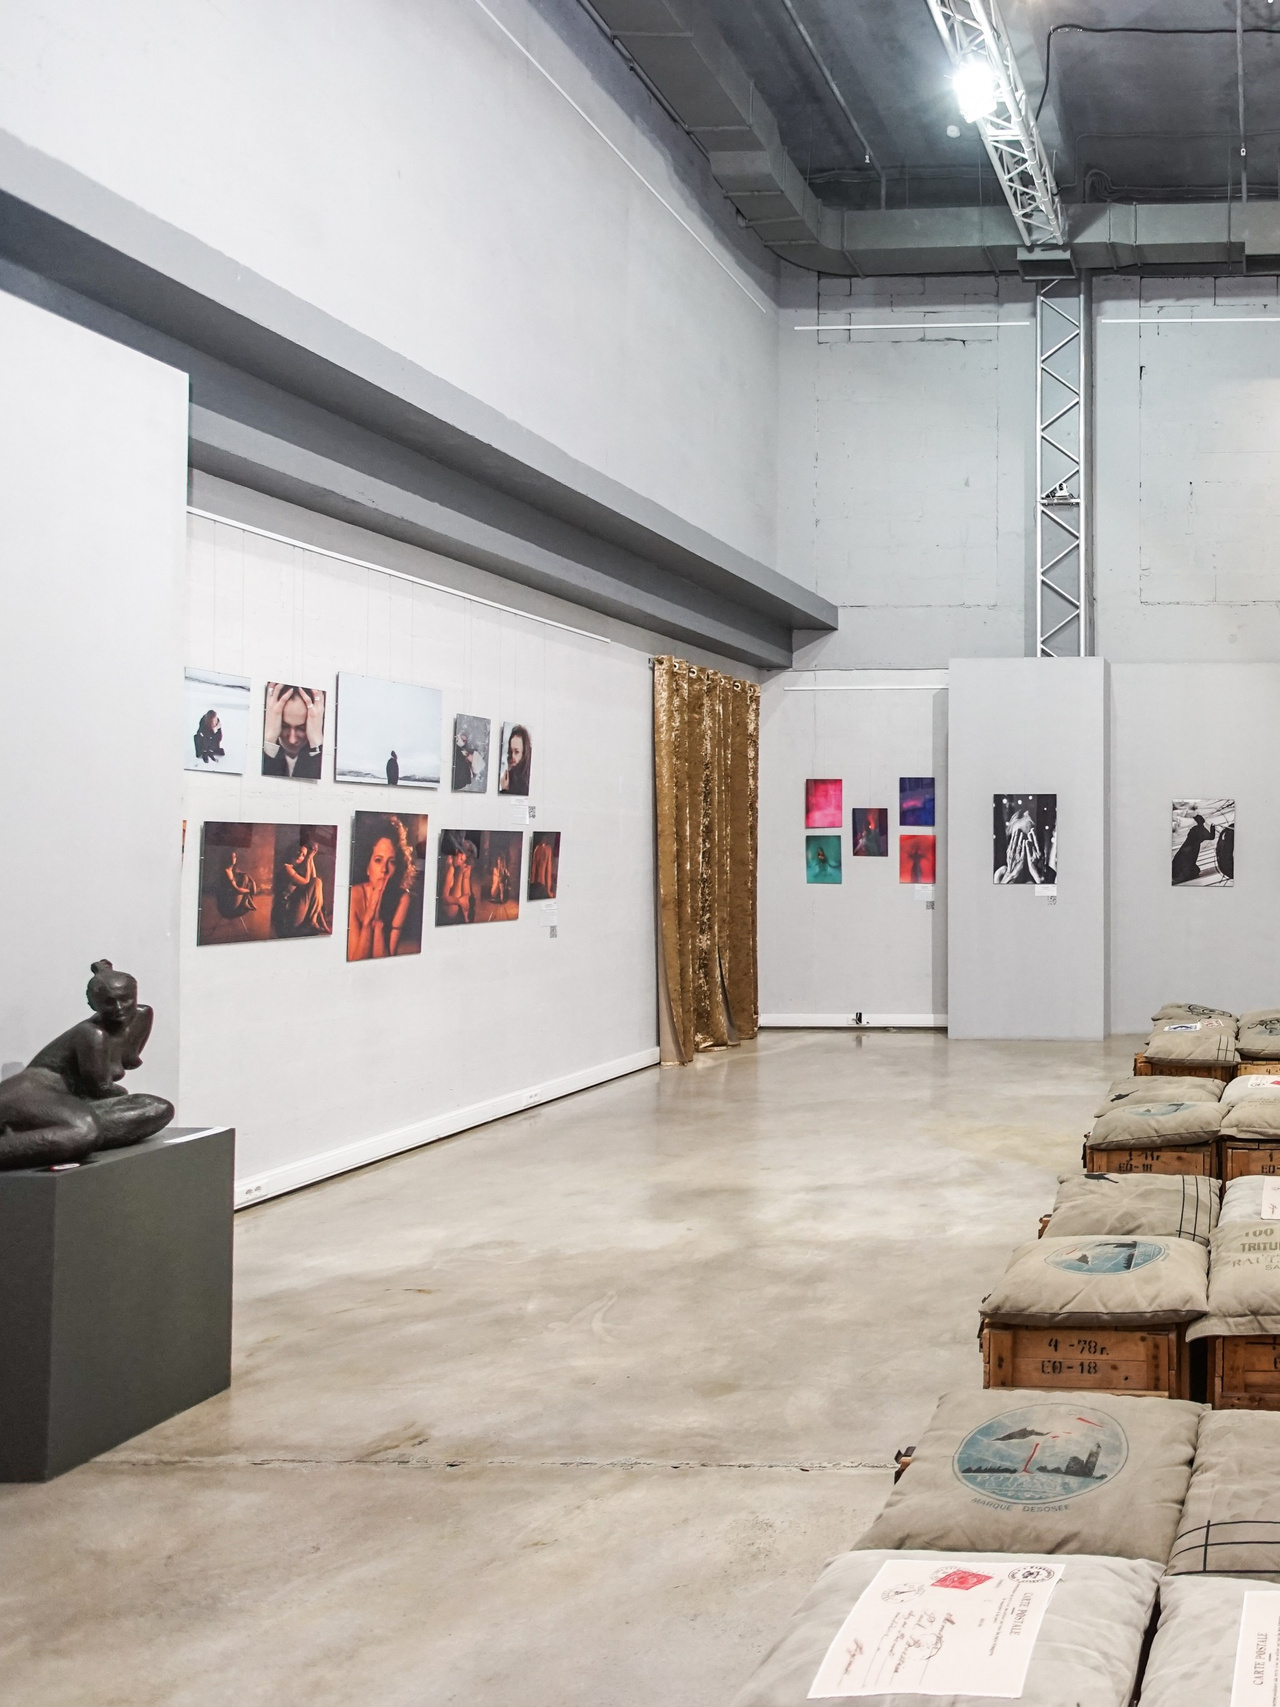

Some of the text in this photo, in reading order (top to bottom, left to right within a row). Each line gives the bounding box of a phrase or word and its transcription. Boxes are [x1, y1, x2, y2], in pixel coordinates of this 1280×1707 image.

[971, 1497, 1013, 1512] MARQUE
[1252, 1632, 1268, 1686] CARTE POSTALE
